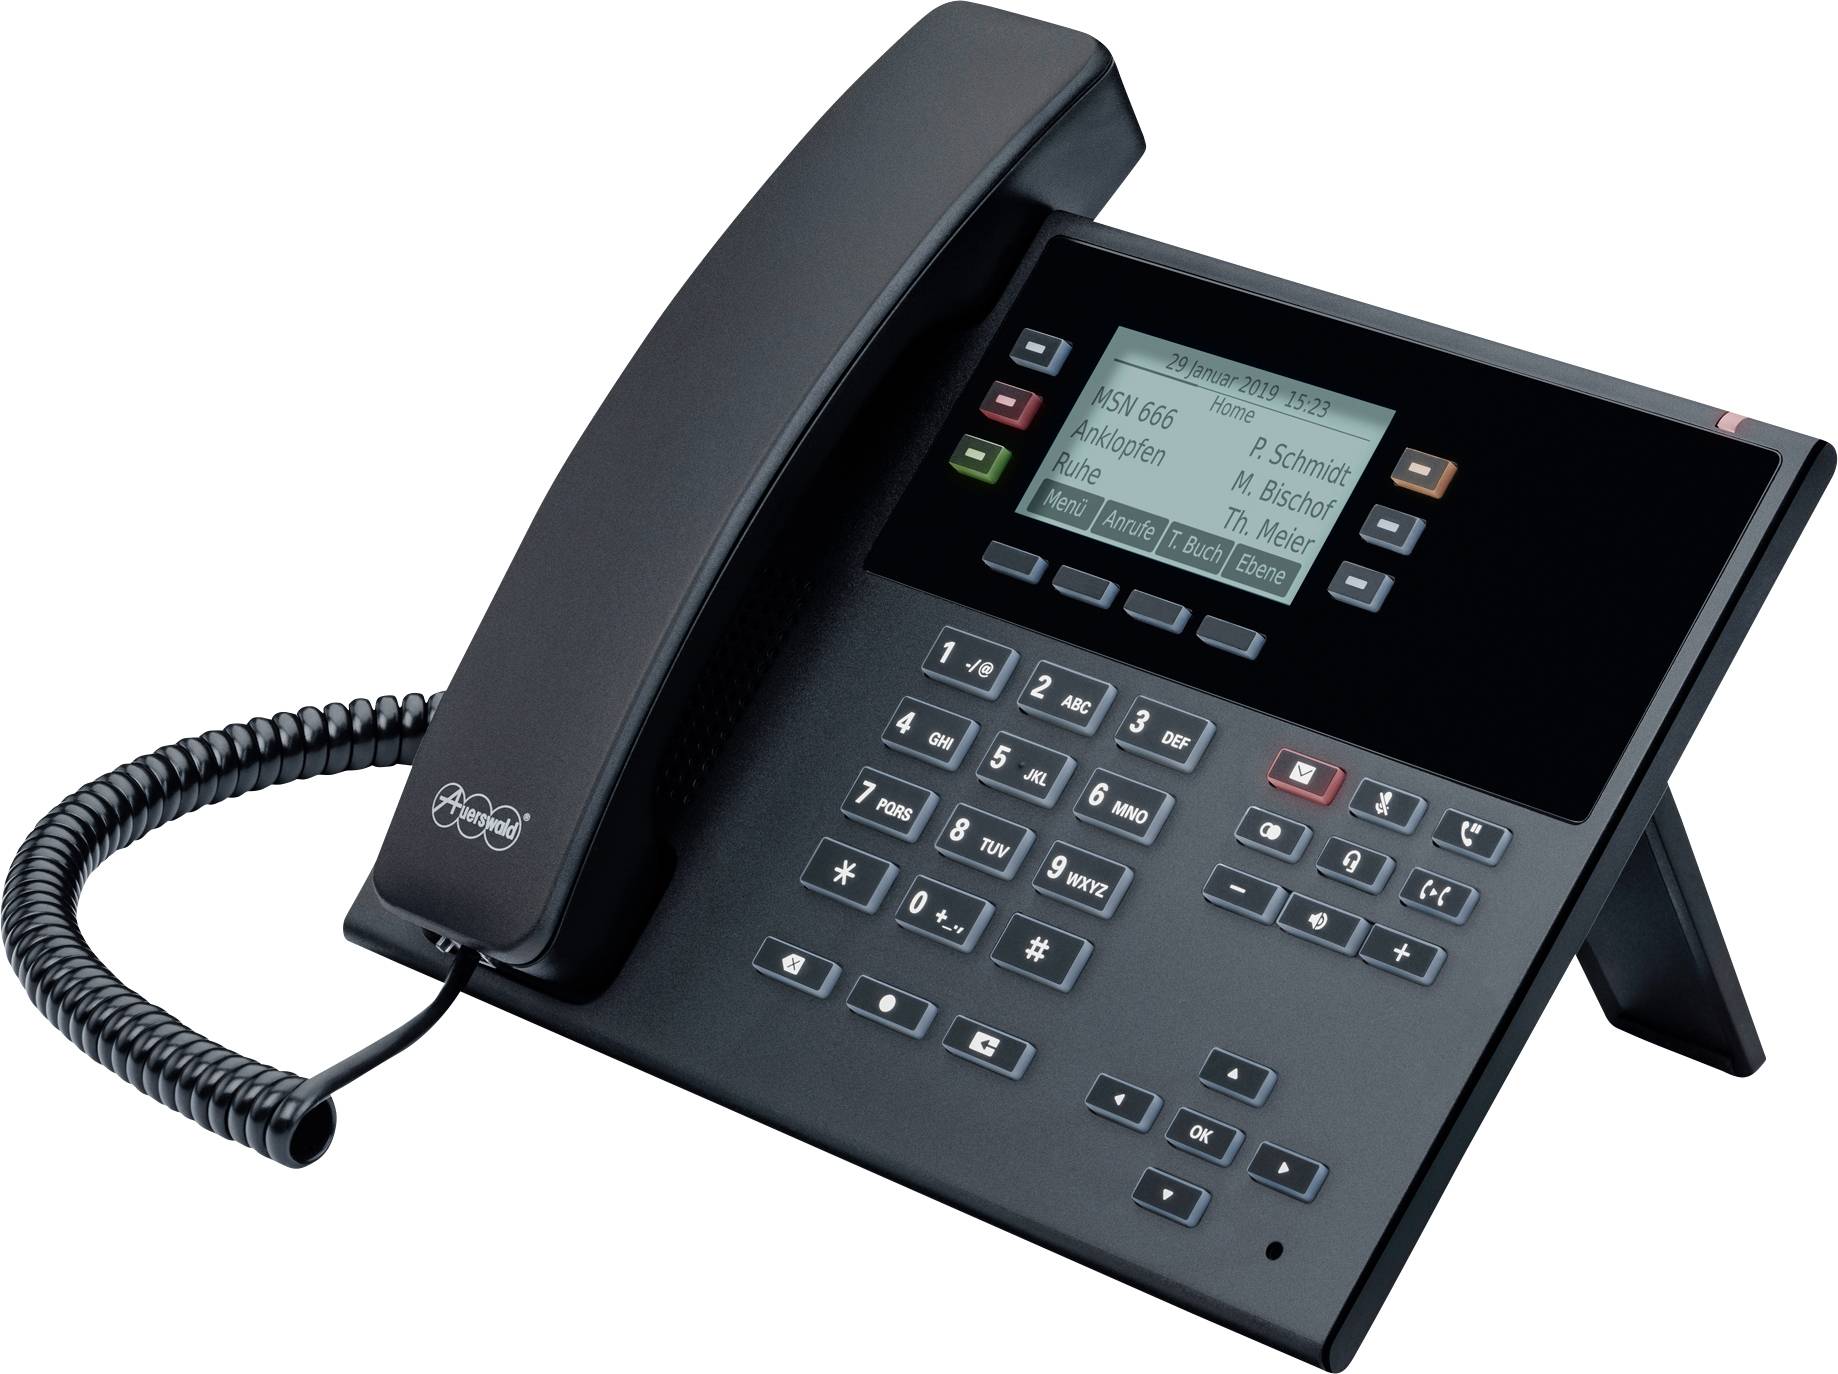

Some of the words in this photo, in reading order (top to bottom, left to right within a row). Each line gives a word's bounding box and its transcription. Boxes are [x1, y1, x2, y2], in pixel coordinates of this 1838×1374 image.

[1166, 353, 1187, 374] 29
[1184, 359, 1236, 391] Januar
[1238, 376, 1280, 402] 2019
[1283, 390, 1331, 418] 15:23
[1091, 386, 1136, 417] MSN
[1137, 401, 1178, 430] 666
[1209, 396, 1256, 424] Home
[1070, 419, 1166, 467] Anklopfen
[1249, 437, 1267, 460] P.
[1269, 443, 1352, 488] Schmidt
[1052, 452, 1102, 485] Ruhe
[1042, 489, 1088, 518] Menü
[1231, 470, 1252, 496] M.
[1259, 479, 1337, 522] Bischof
[1102, 510, 1156, 541] Anrufe
[1223, 506, 1248, 535] Th.
[1256, 518, 1316, 555] Meier
[1166, 530, 1181, 548] T.
[1181, 536, 1224, 563] Buch
[1235, 554, 1286, 585] Ebene
[939, 641, 955, 664] 1
[1030, 674, 1052, 699] 2
[1060, 695, 1092, 715] ABC
[895, 711, 916, 734] 4
[928, 731, 955, 751] GHI
[1129, 710, 1150, 734] 3
[1161, 731, 1192, 751] DEF
[989, 745, 1011, 769] 5
[1023, 767, 1047, 787] JKL
[432, 787, 520, 840] Auerswald
[855, 781, 877, 804] 7
[874, 797, 914, 822] PQRS
[1088, 782, 1108, 806] 6
[1111, 800, 1149, 824] MNO
[949, 818, 970, 842] 8
[979, 837, 1010, 858] TUV
[1047, 855, 1067, 879] 9
[1066, 872, 1109, 898] WXYZ
[909, 890, 928, 914] 0
[1189, 1125, 1214, 1144] OK
